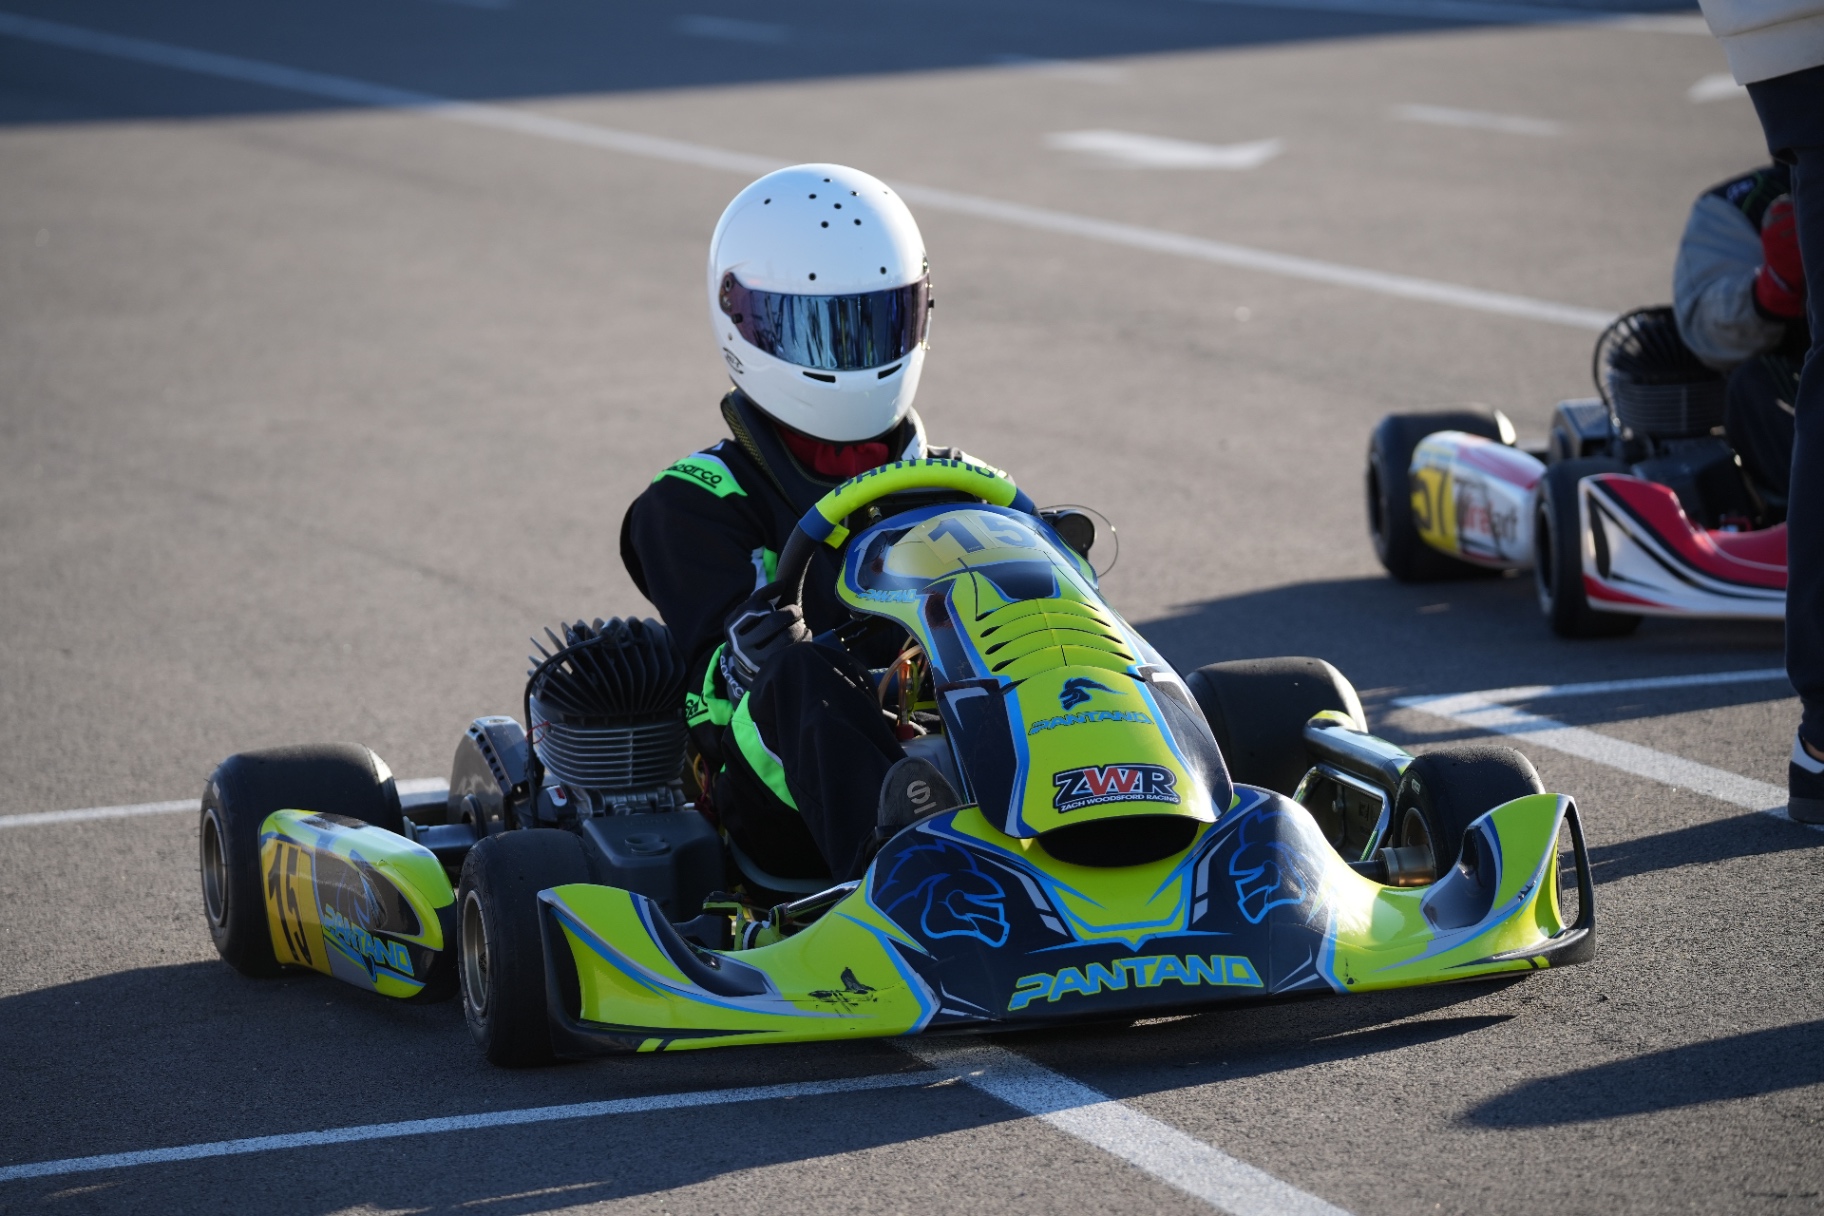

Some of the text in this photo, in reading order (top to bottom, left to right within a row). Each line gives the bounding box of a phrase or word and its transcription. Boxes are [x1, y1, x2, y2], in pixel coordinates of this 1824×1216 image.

[927, 514, 1037, 554] 15
[1056, 765, 1177, 805] ZWR
[1060, 793, 1180, 813] ZACH WOODSFORD RACING
[267, 842, 313, 966] 15
